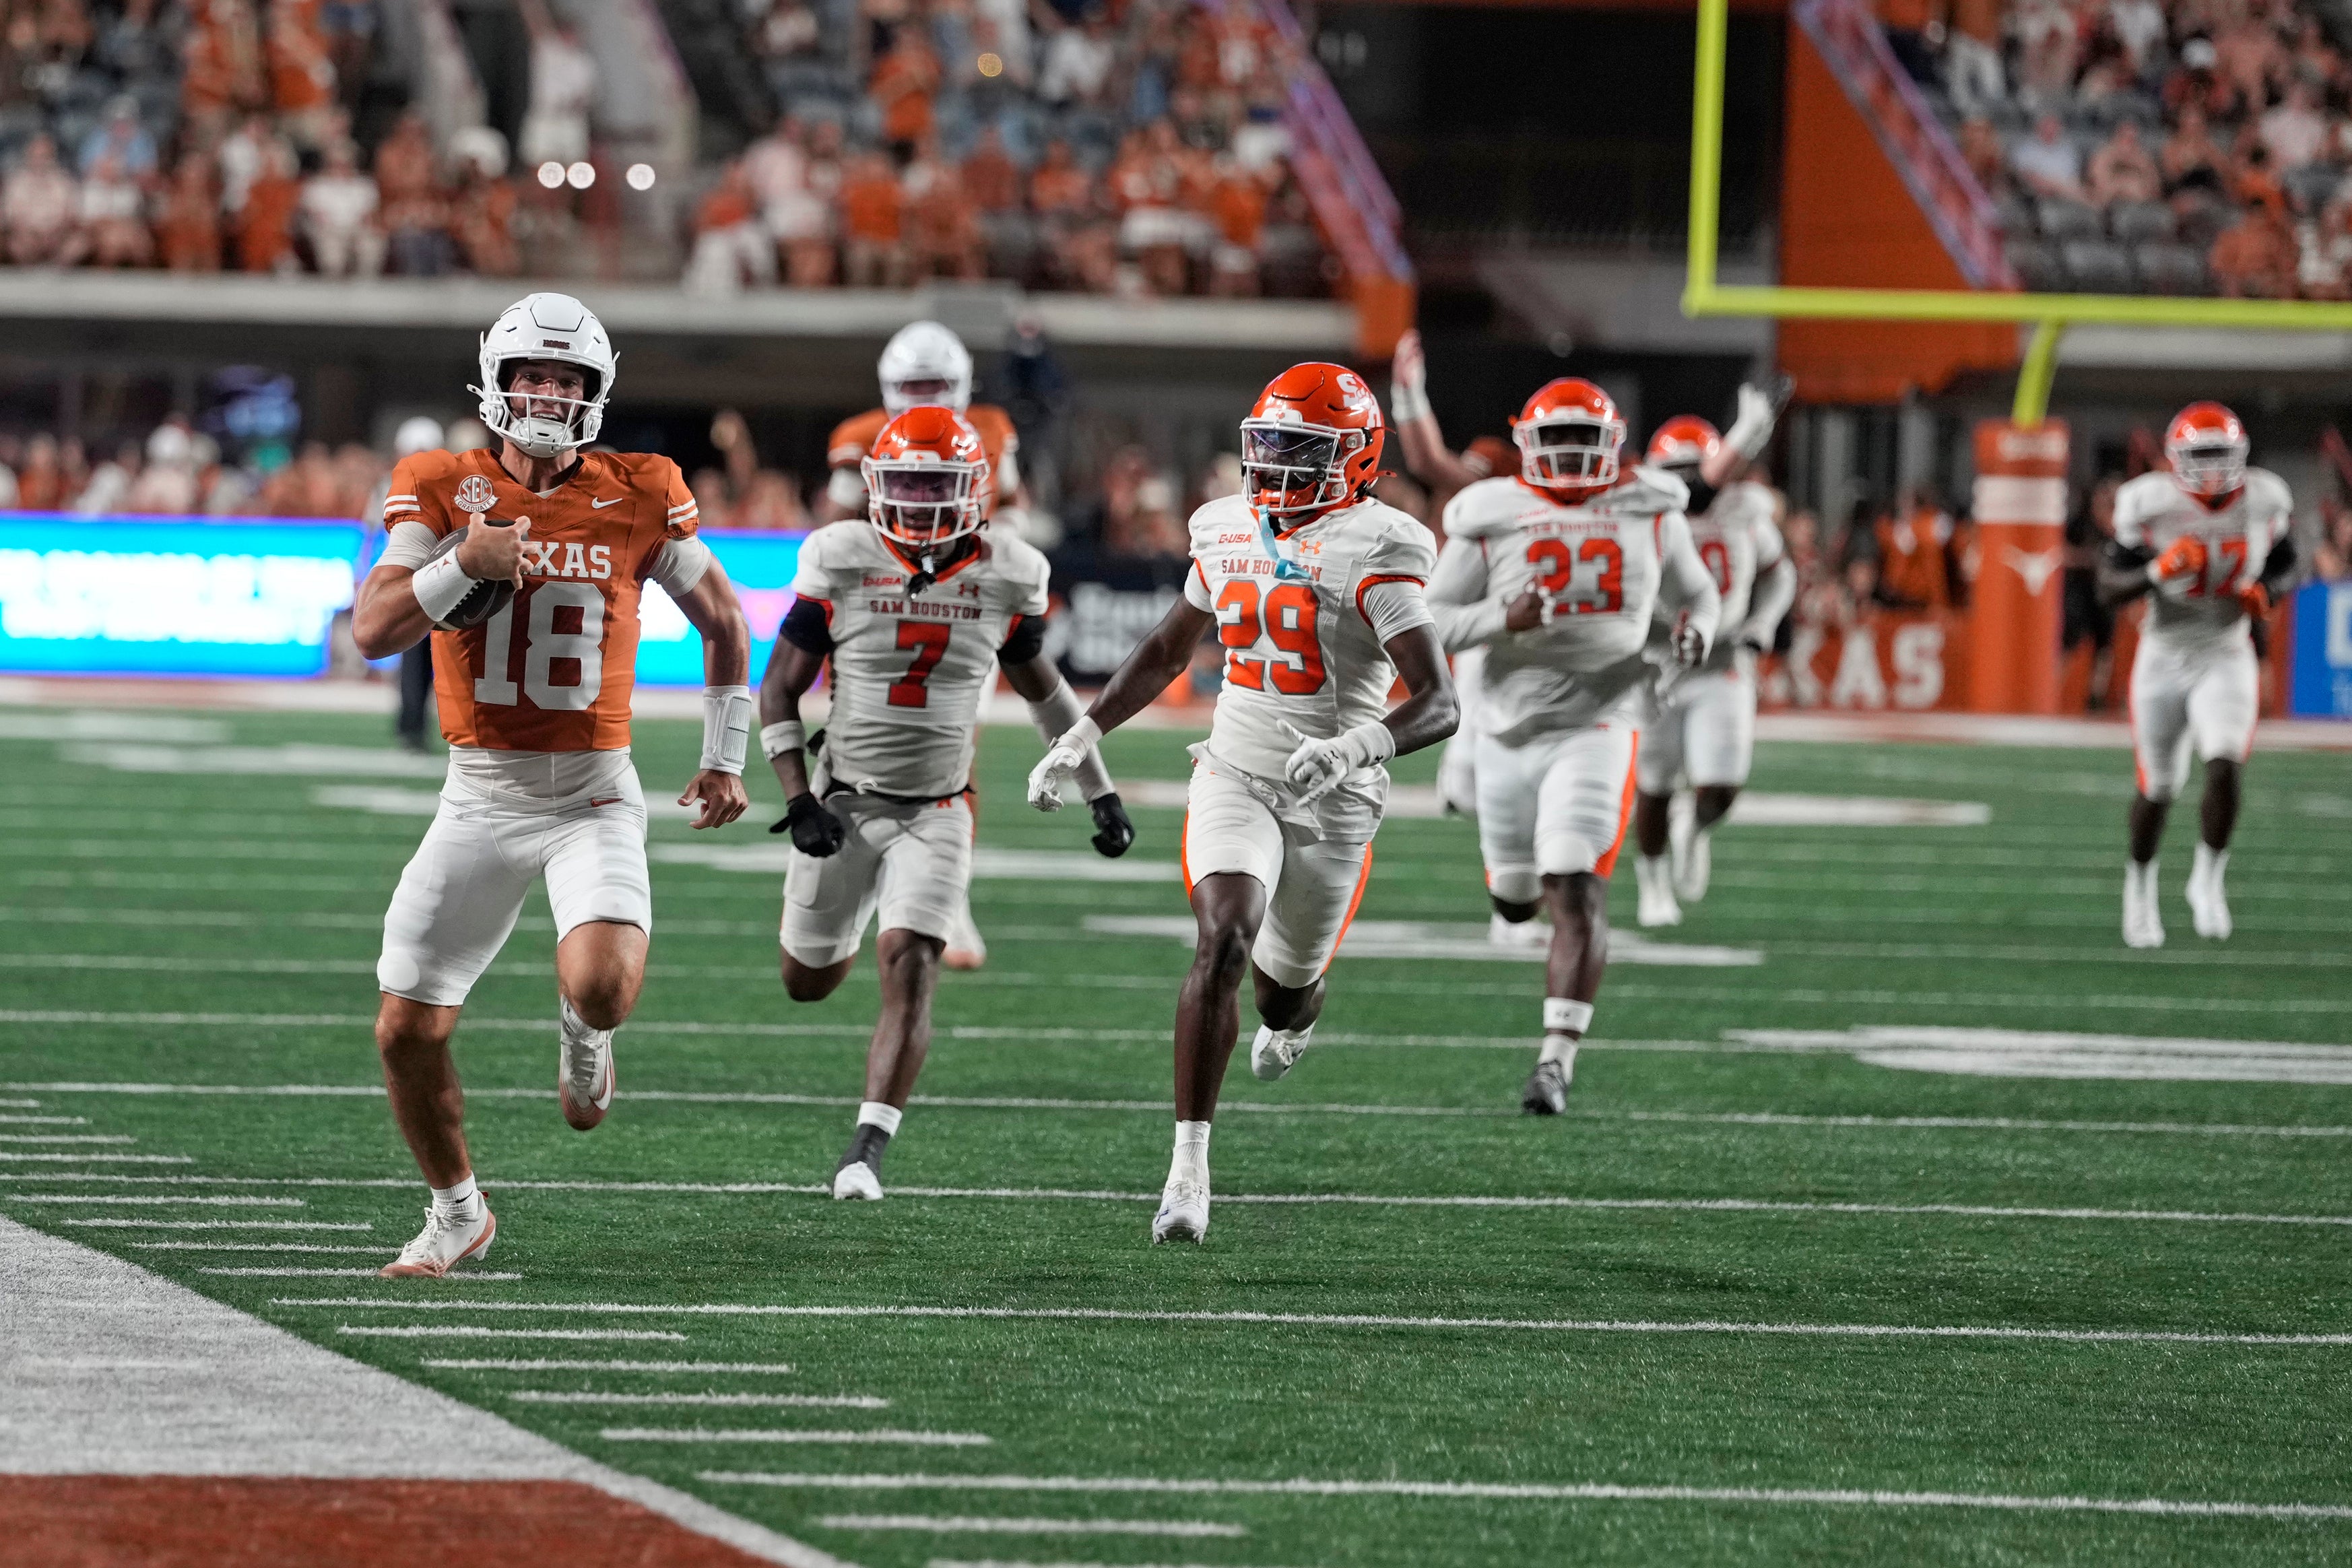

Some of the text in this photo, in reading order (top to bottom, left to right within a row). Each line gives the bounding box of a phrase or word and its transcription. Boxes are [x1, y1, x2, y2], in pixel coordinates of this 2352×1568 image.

[457, 500, 492, 512] GRADUATE
[461, 477, 490, 502] SEC
[523, 541, 611, 580] XAS
[1222, 558, 1249, 574] SAM
[1526, 536, 1624, 618] 23
[870, 600, 982, 620] SAM HOUSTON
[474, 581, 606, 711] 18
[1216, 579, 1328, 695] 29
[888, 619, 952, 708] 7
